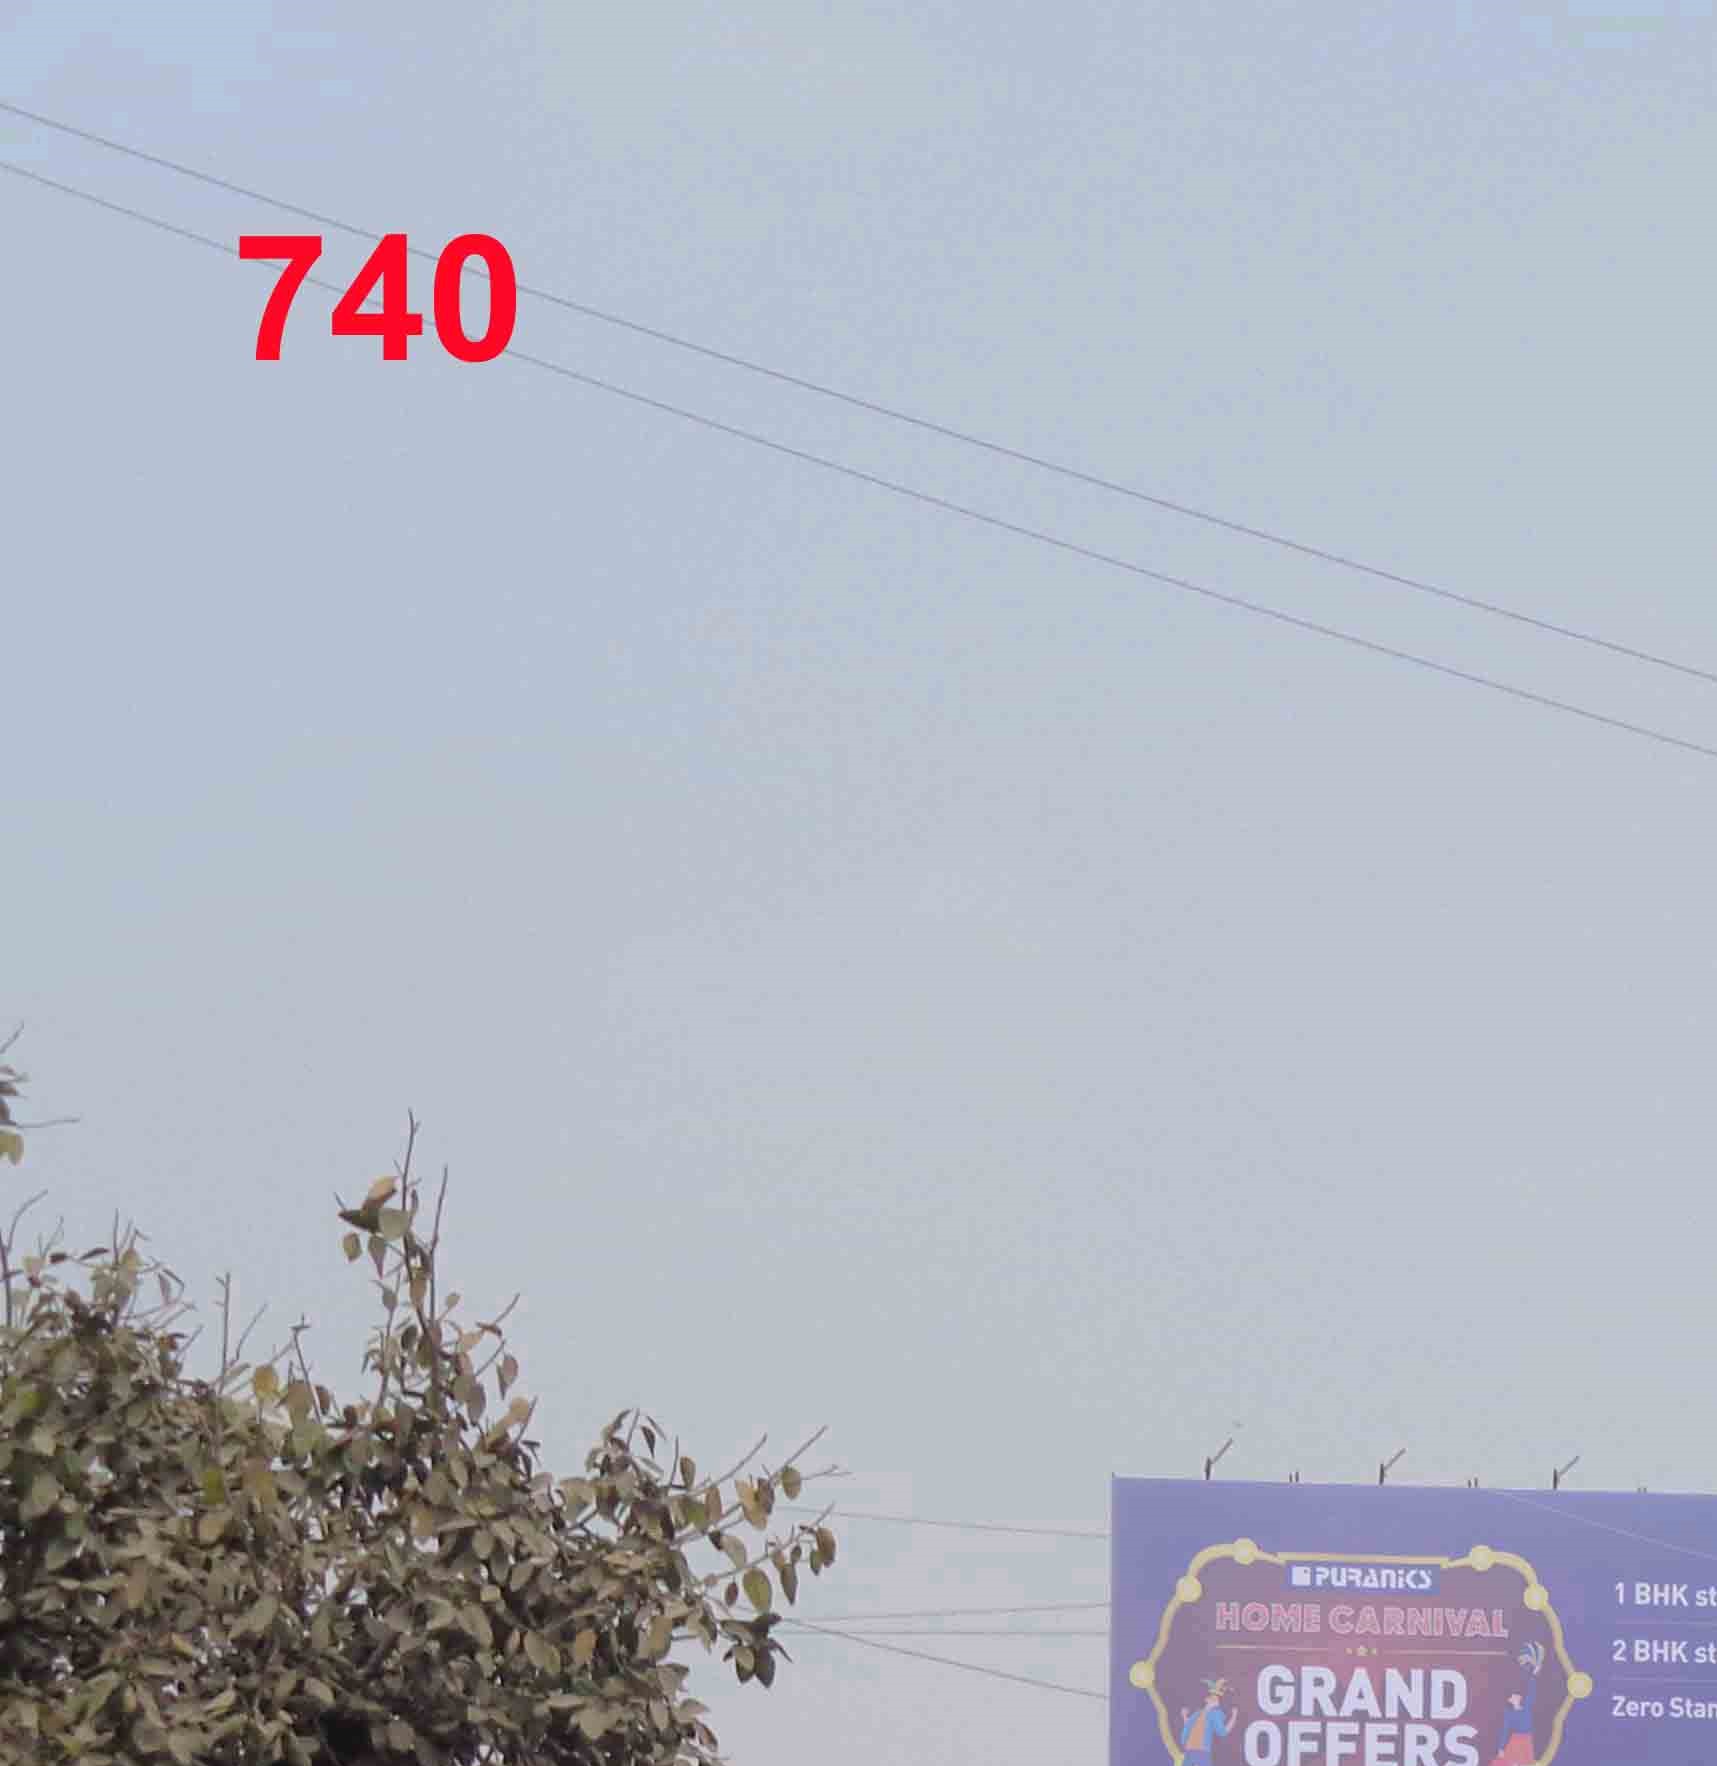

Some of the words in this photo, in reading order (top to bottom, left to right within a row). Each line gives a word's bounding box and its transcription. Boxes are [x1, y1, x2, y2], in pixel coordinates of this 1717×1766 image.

[1614, 1582, 1625, 1606] 1
[1634, 1582, 1689, 1607] BHK
[1215, 1601, 1321, 1634] HOME
[1328, 1603, 1509, 1640] CARNIVAL
[1612, 1640, 1627, 1663] 2
[1634, 1640, 1689, 1664] BHK
[1256, 1664, 1469, 1721] GRAND
[1612, 1696, 1664, 1719] Zero
